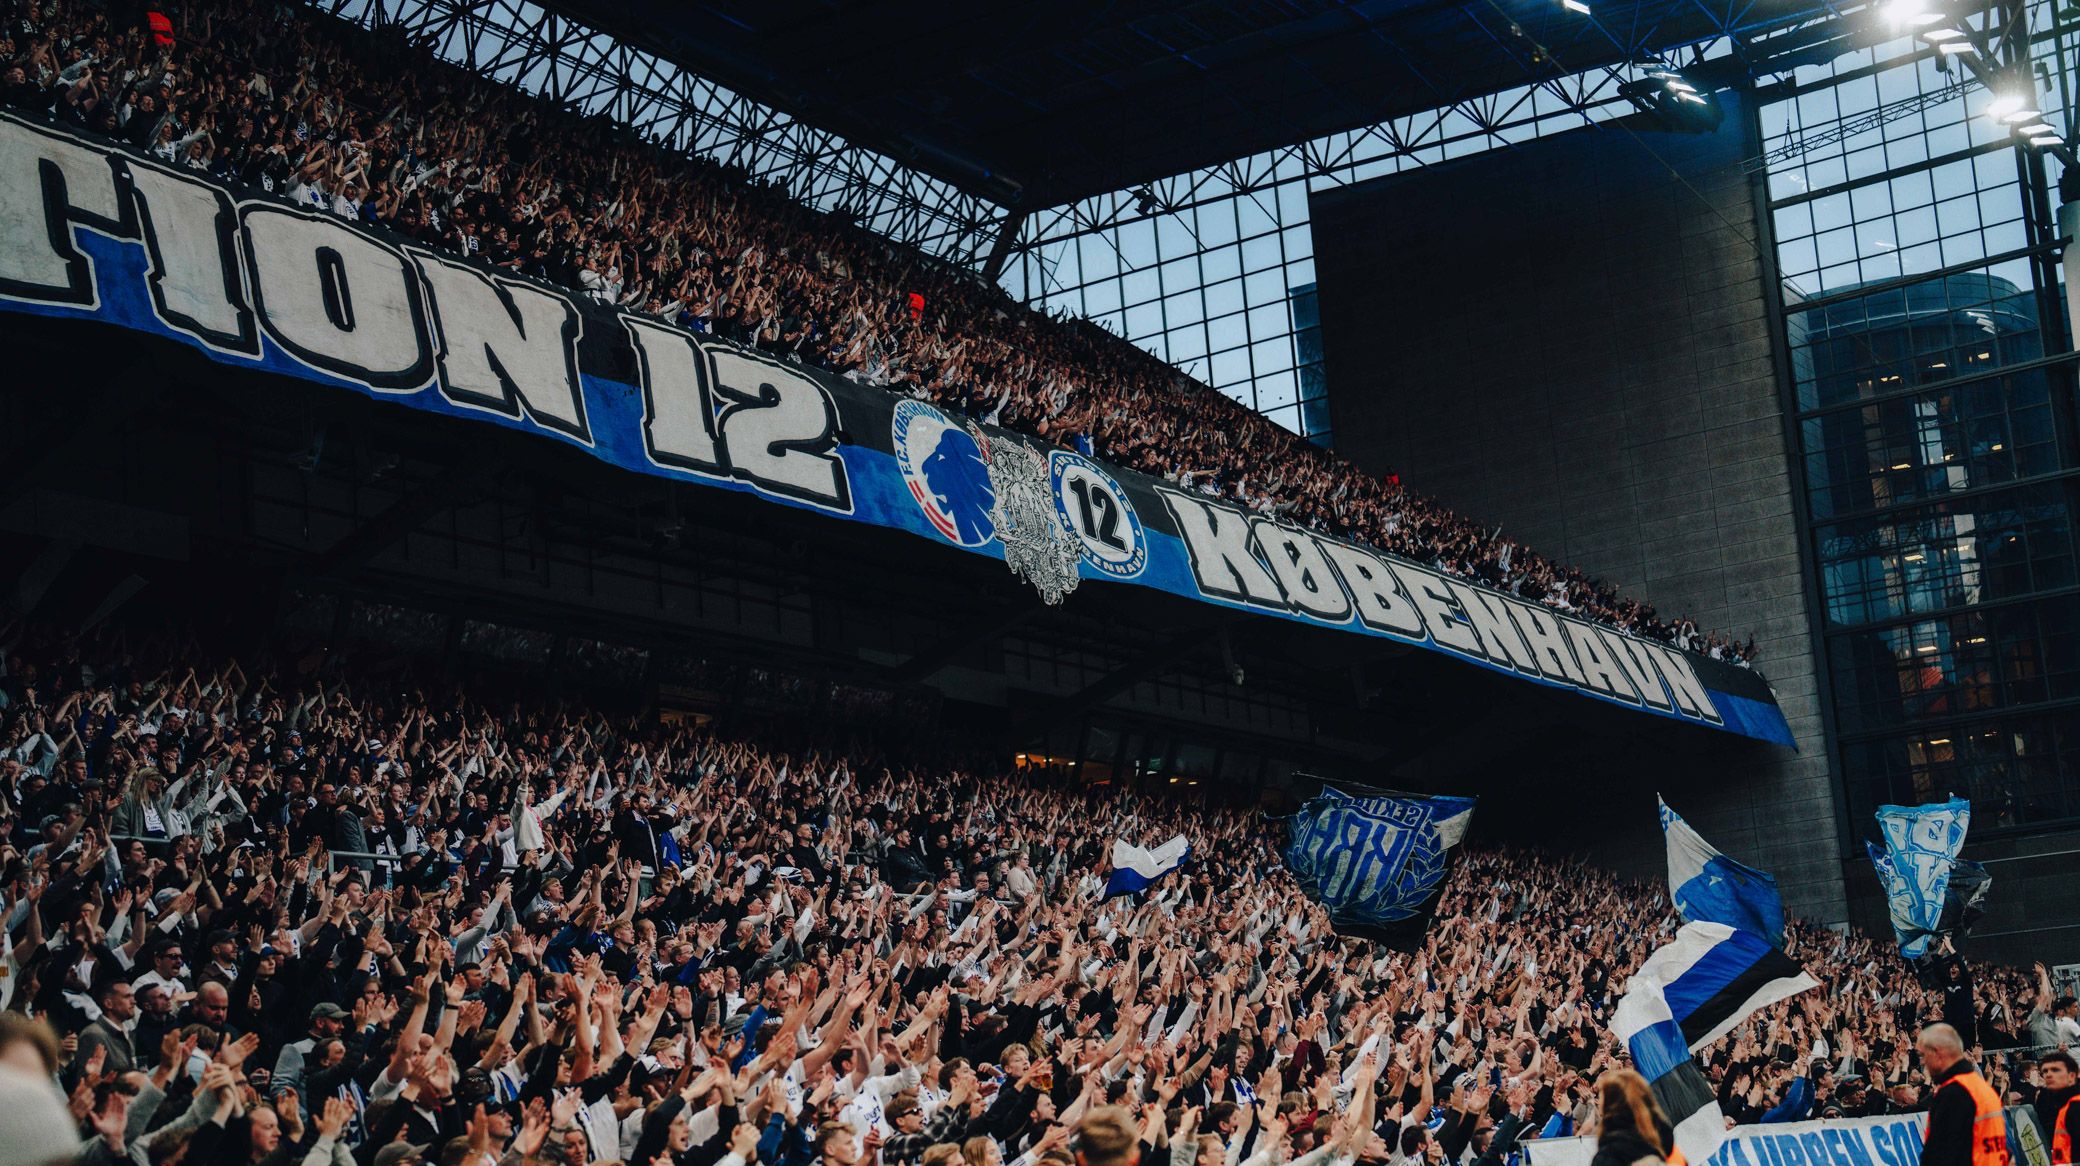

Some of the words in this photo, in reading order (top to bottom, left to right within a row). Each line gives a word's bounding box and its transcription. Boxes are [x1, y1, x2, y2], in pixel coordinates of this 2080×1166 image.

[618, 313, 853, 514] 12
[1060, 512, 1144, 574] KBENHAVN
[1066, 475, 1128, 554] 12
[1153, 486, 1723, 726] KØBENHAVN
